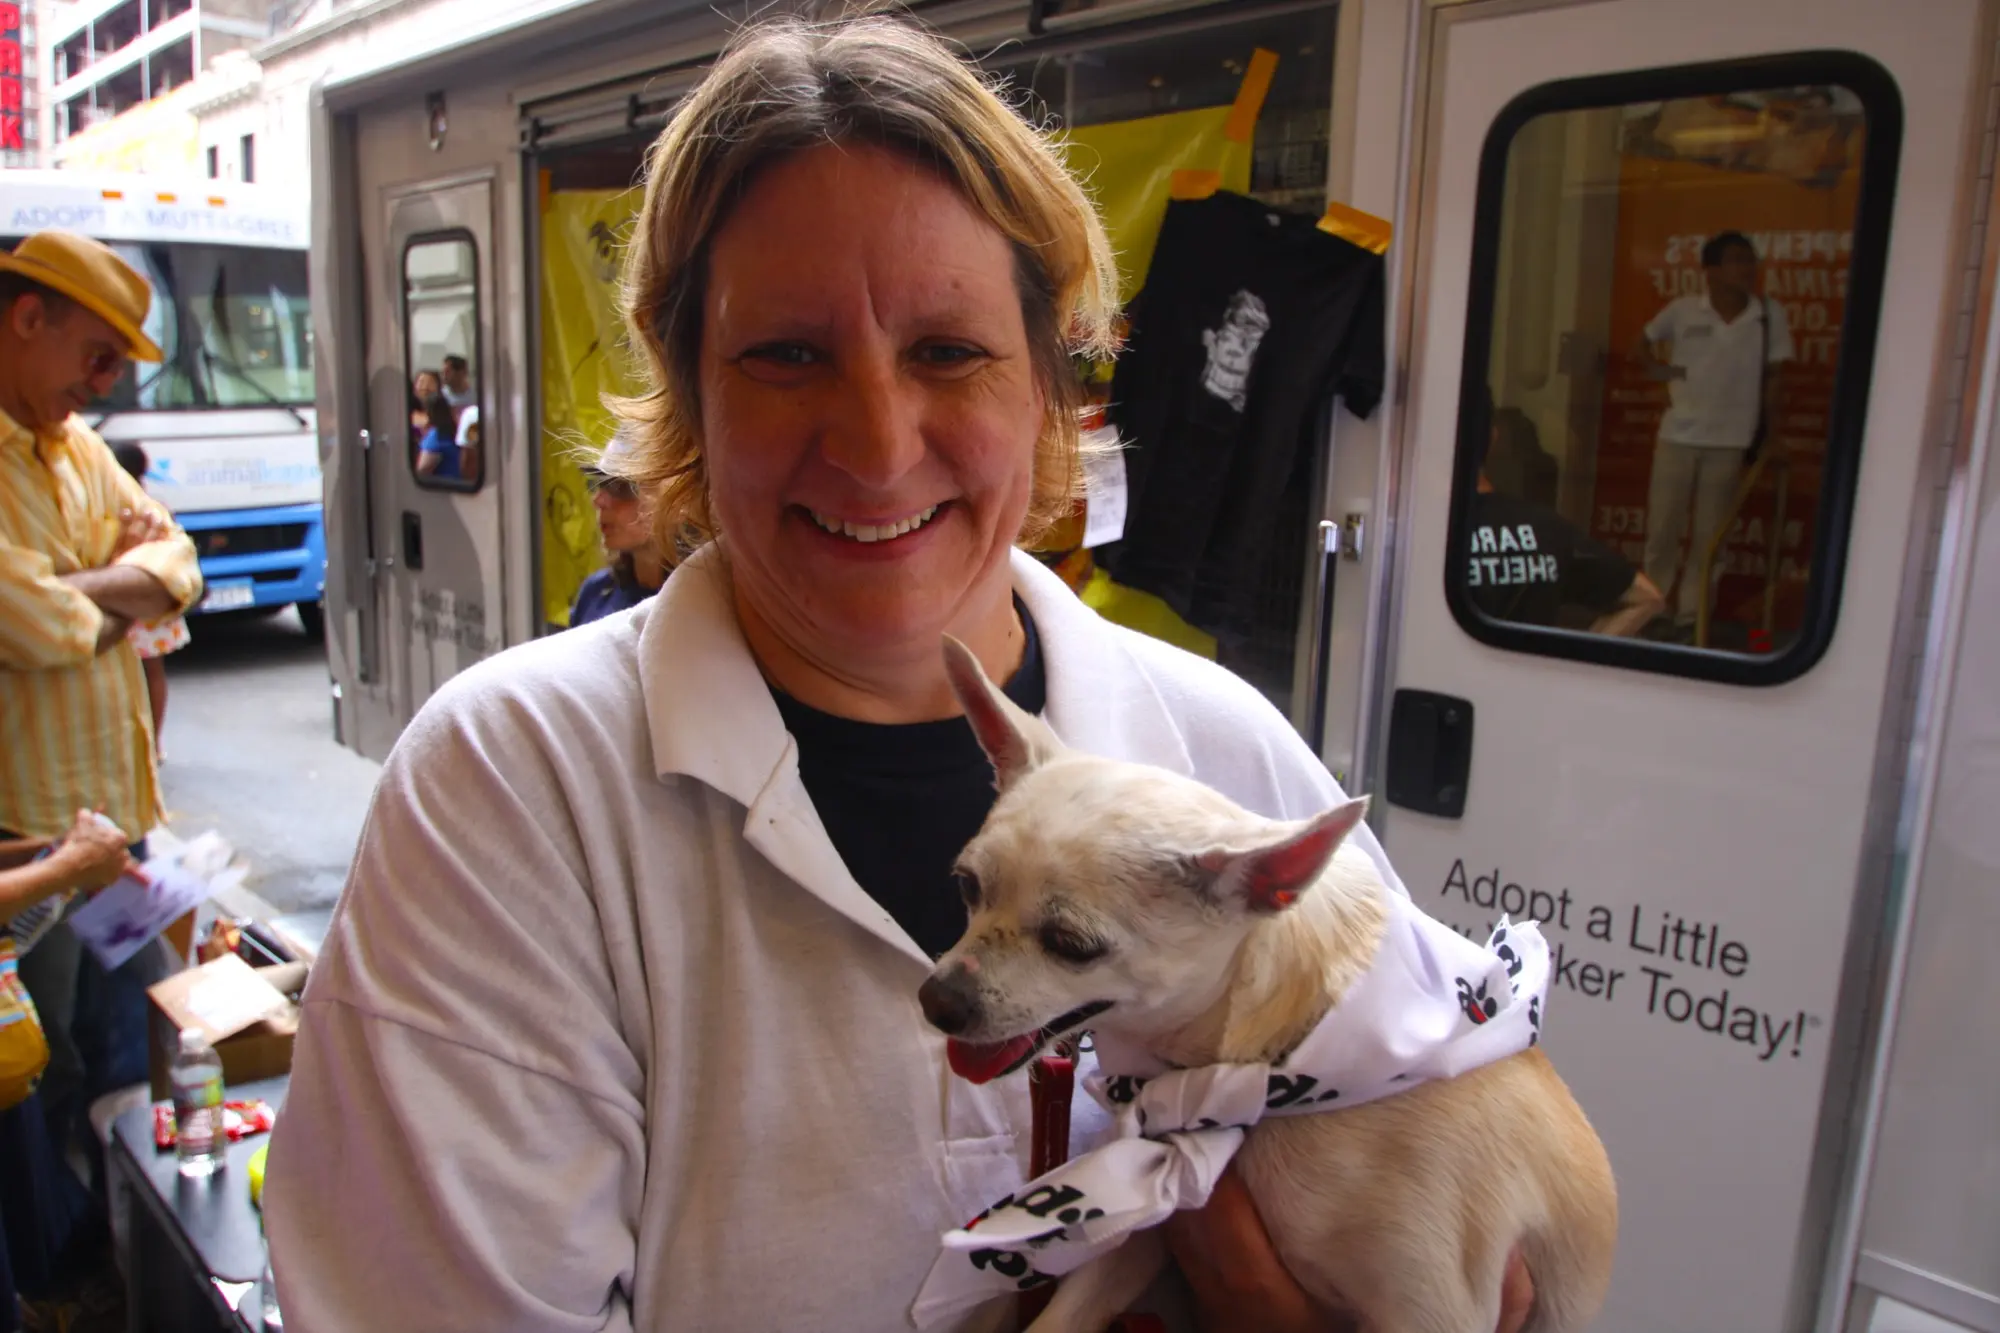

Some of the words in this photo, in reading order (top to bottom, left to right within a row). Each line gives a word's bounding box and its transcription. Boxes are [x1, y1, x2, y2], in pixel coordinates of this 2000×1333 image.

[12, 205, 105, 228] ADOPT
[1441, 858, 1574, 931] Adopt
[1586, 905, 1613, 942] a
[1629, 904, 1750, 978] Little
[1549, 945, 1625, 1001] ker
[1640, 966, 1807, 1061] Today!
